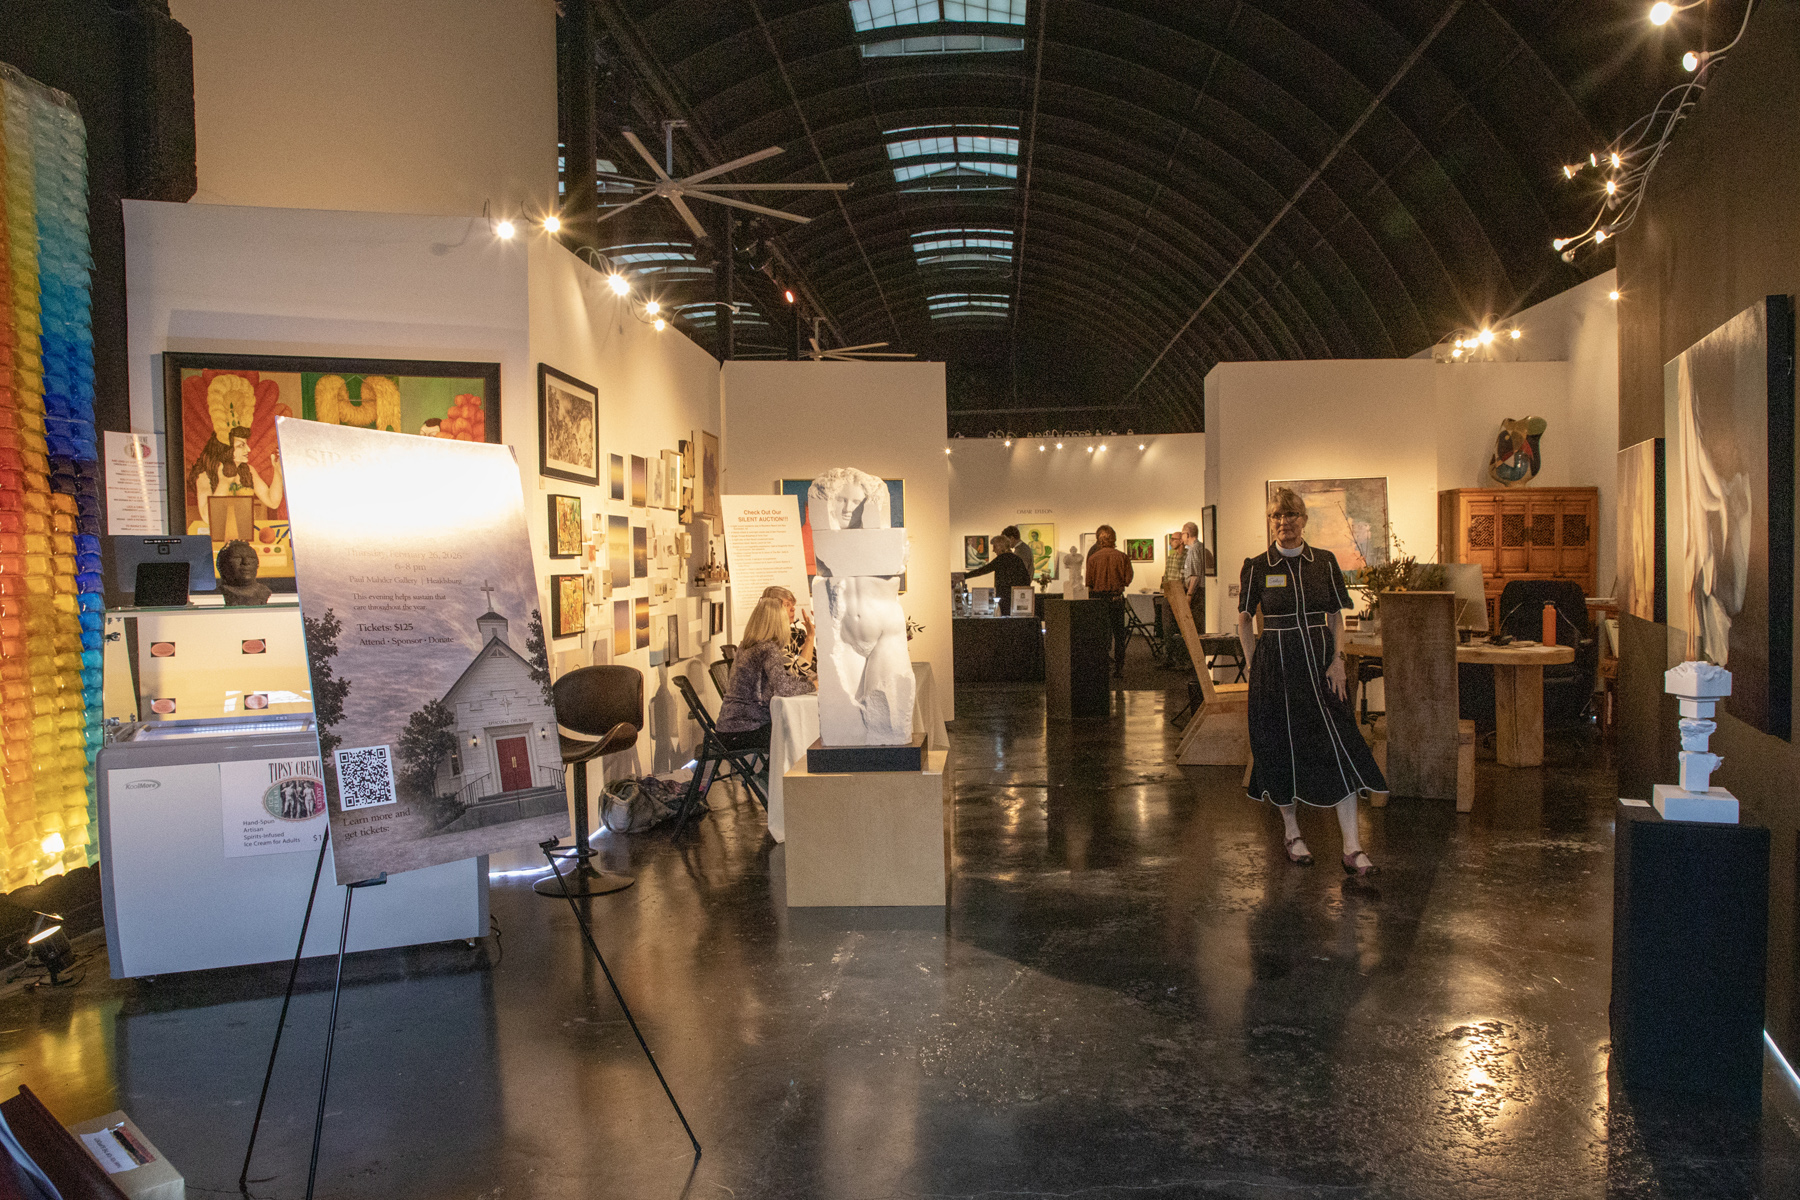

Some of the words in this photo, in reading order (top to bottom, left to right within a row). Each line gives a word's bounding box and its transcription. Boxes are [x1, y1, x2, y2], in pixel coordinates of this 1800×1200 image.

[389, 550, 426, 560] February
[428, 552, 441, 560] 26,
[442, 552, 462, 560] 2026
[413, 564, 427, 572] pm
[349, 575, 364, 583] Paul
[366, 576, 392, 584] Mahder
[394, 577, 417, 585] Gallery
[426, 577, 462, 585] Healdsburg
[369, 594, 394, 602] evening
[395, 593, 411, 602] helps
[368, 604, 401, 612] throughout
[357, 623, 392, 632] Tickets:
[394, 622, 414, 632] $125
[359, 638, 385, 646] Attend
[391, 637, 423, 646] Sponsor
[428, 636, 454, 644] Donate
[268, 761, 293, 783] TIPSY
[343, 816, 369, 826] Learn
[371, 813, 393, 822] more
[395, 807, 411, 818] and
[243, 832, 285, 841] Spirits-Infused
[344, 830, 358, 841] get
[360, 825, 390, 837] tickets:
